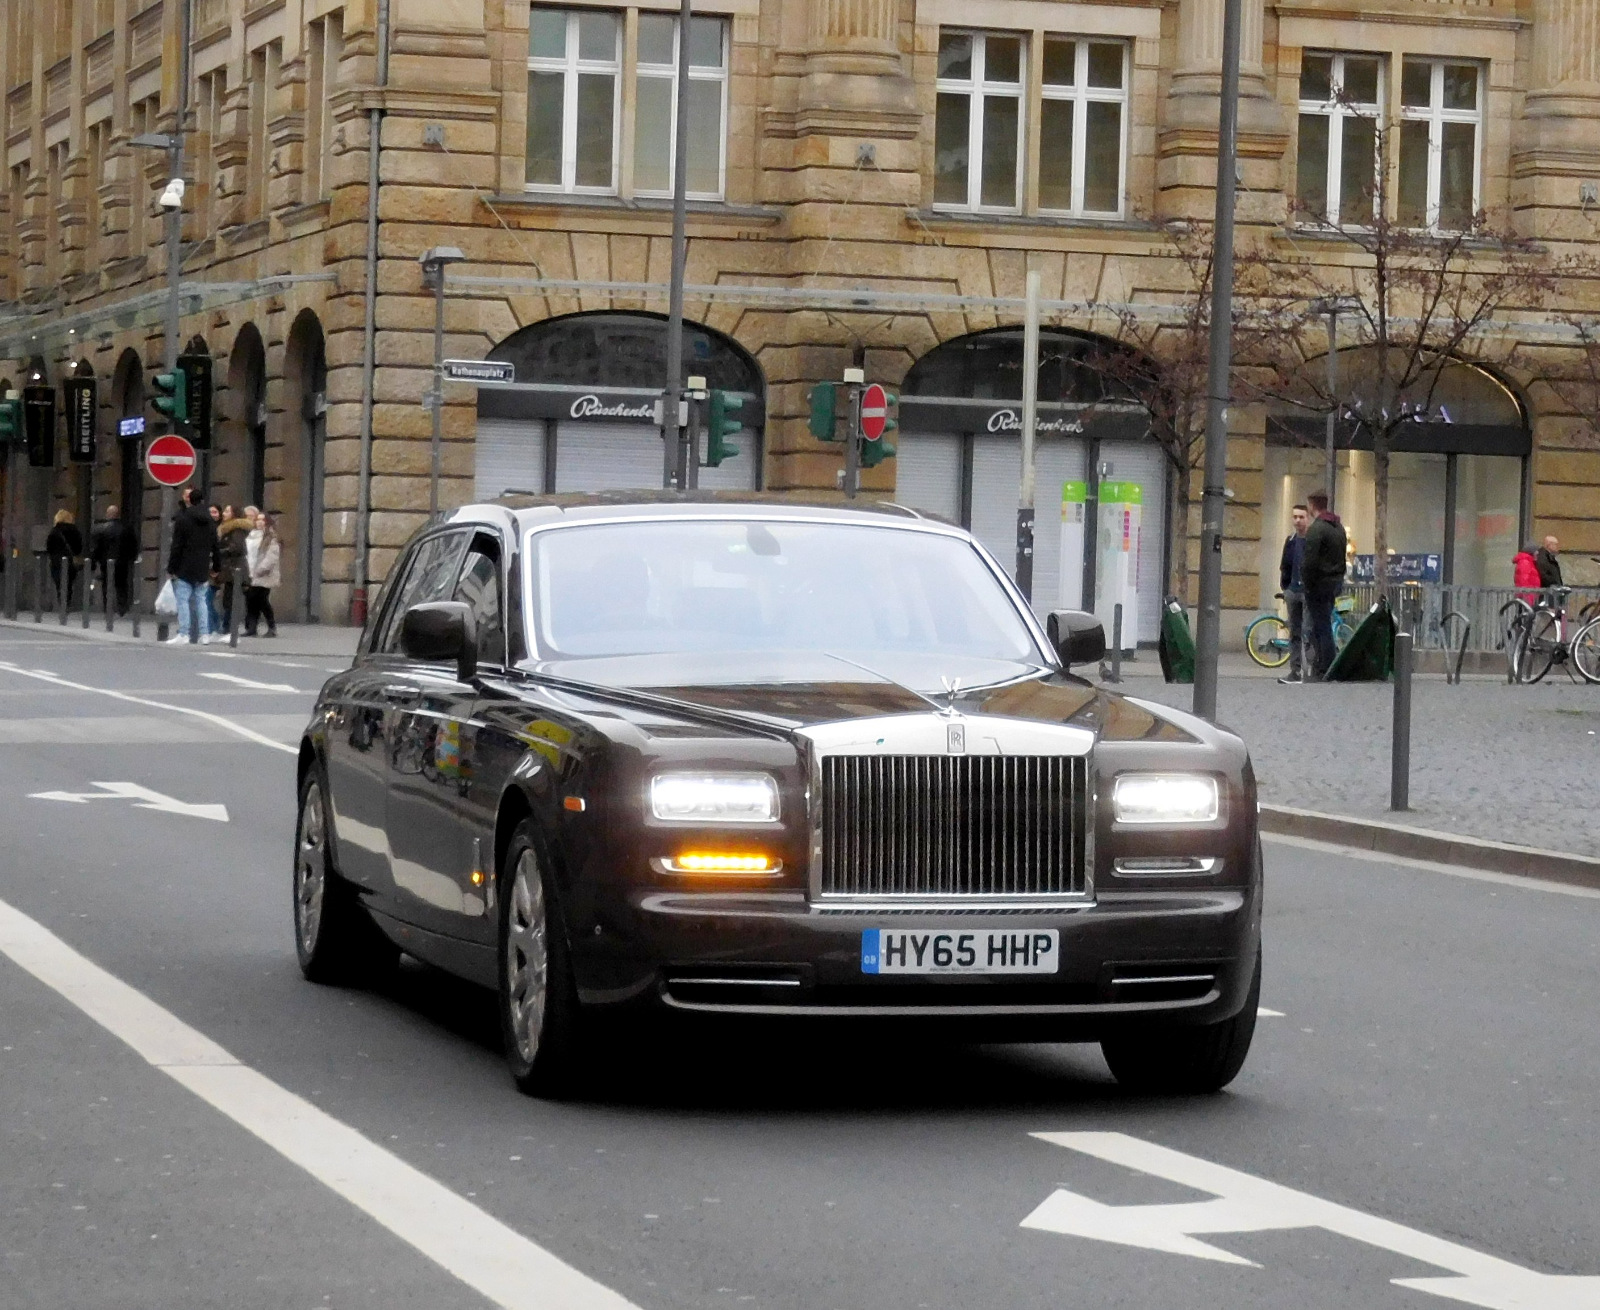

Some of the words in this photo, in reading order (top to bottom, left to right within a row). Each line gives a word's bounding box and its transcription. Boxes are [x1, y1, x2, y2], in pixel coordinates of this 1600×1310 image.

[81, 388, 92, 453] BREITLING
[570, 394, 656, 419] Rüschenbe
[987, 409, 1084, 433] Rüenbeck
[886, 934, 976, 967] HY65
[987, 934, 1052, 967] HHP
